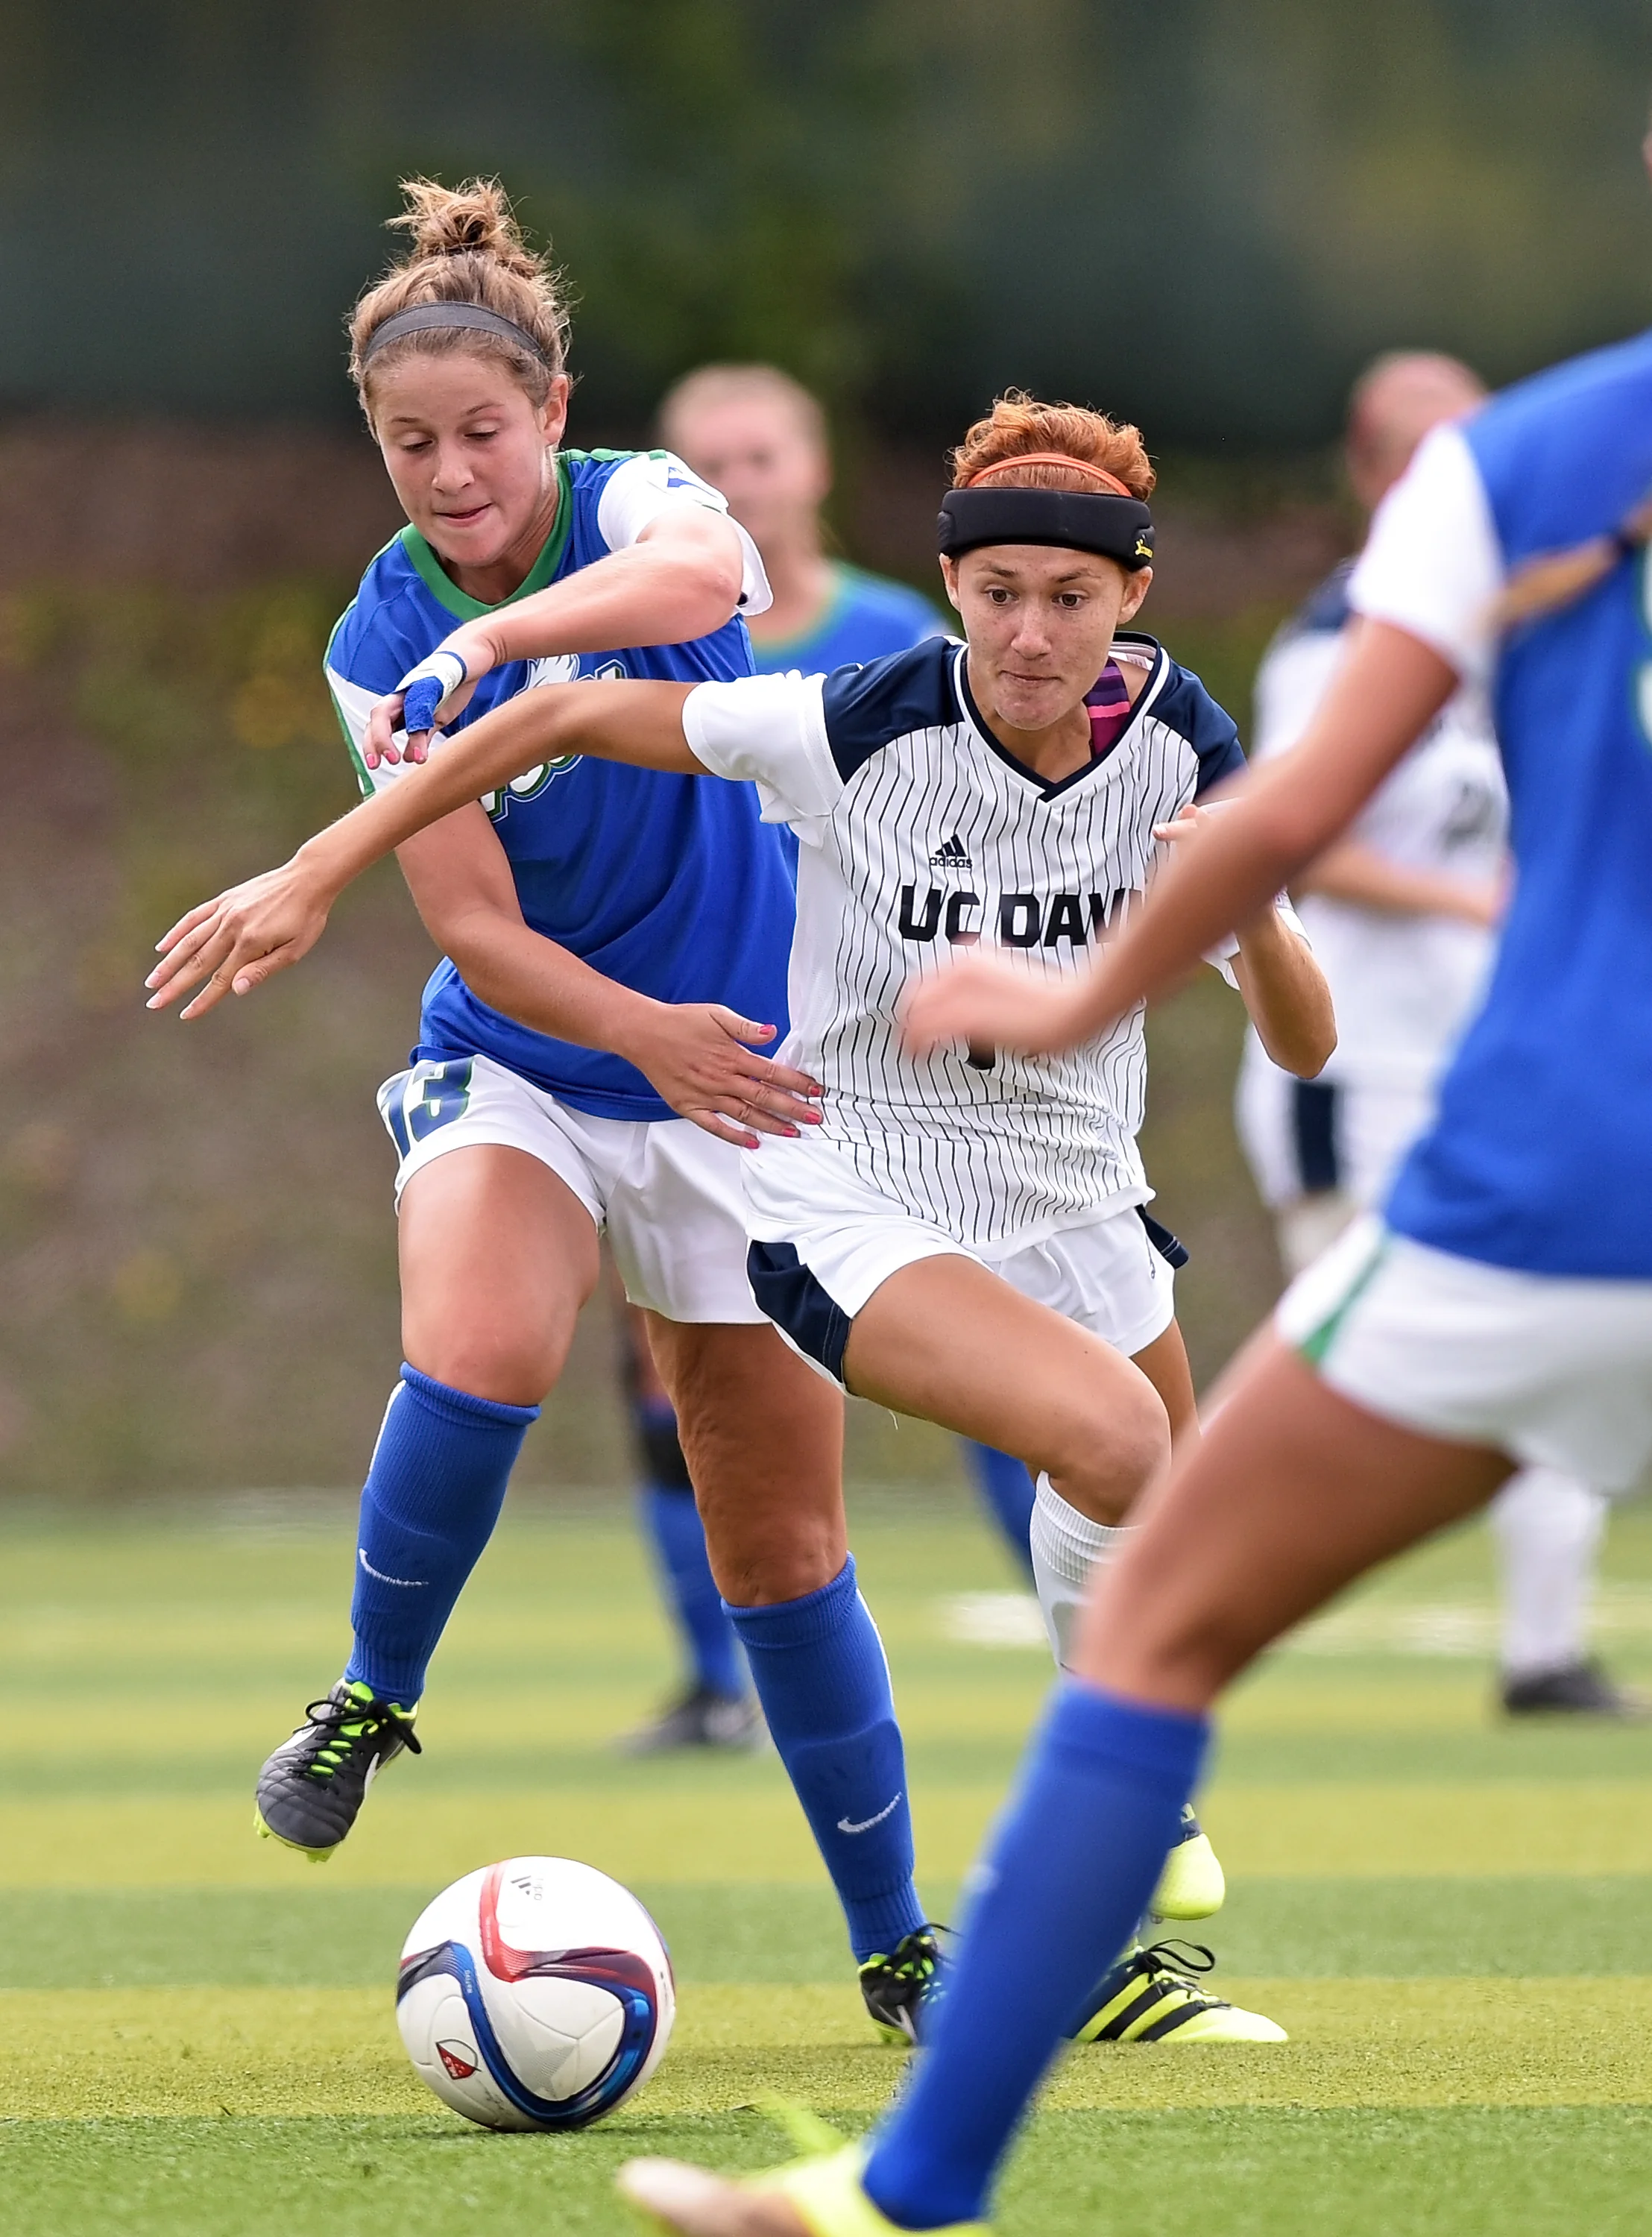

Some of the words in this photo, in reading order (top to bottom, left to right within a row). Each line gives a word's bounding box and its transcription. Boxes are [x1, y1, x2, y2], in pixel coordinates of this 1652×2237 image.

[929, 855, 973, 869] adidas
[898, 884, 981, 946] UC
[380, 1056, 475, 1162] 13
